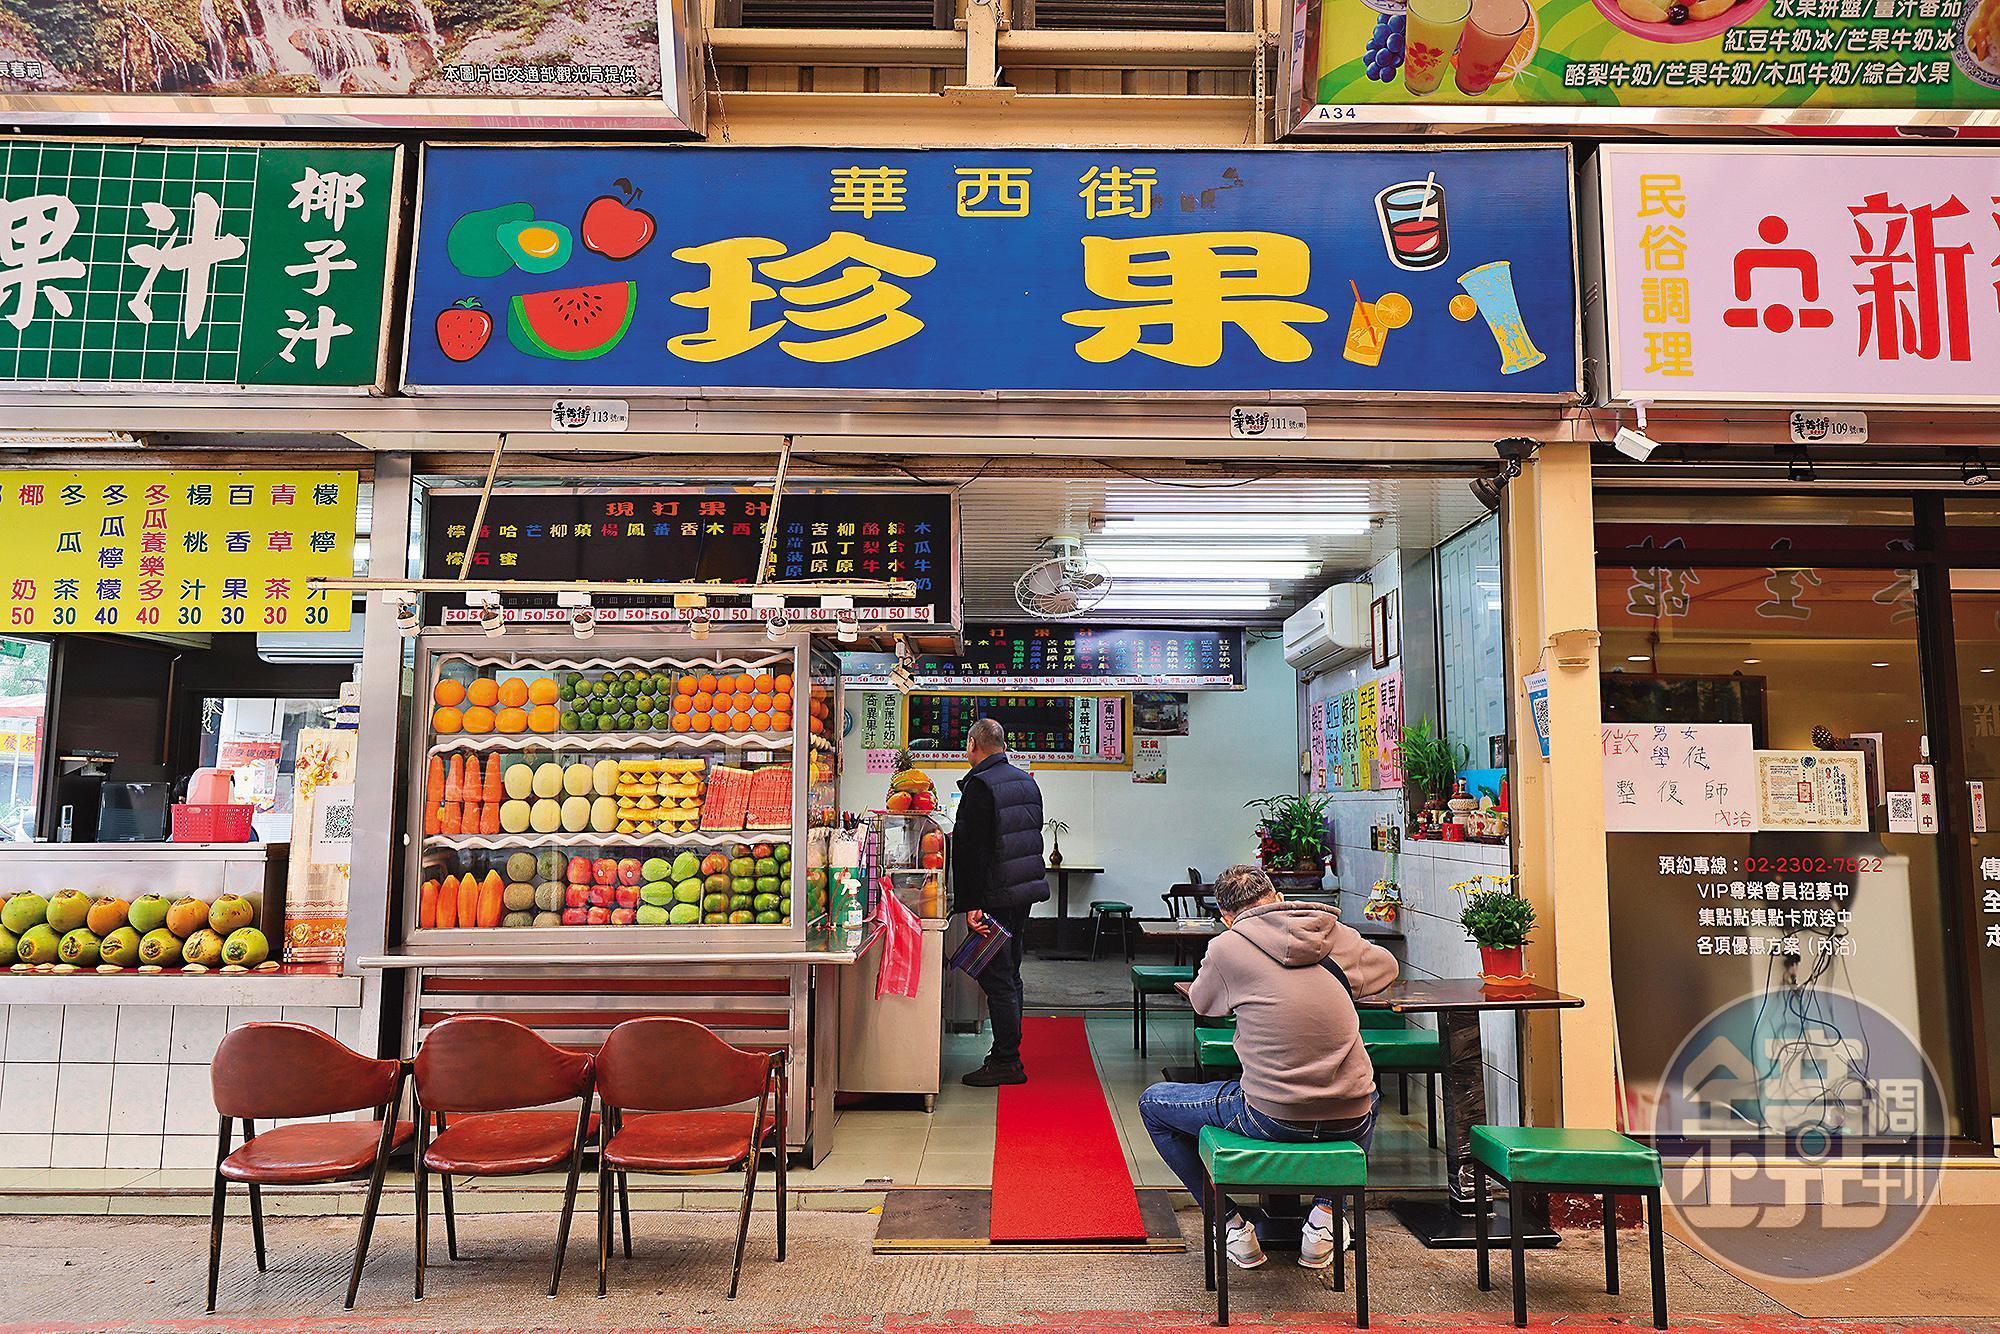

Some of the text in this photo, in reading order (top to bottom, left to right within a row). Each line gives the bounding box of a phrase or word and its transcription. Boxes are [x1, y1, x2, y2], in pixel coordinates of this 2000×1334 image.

[1724, 27, 1956, 52] 紅豆牛奶冰/芒果牛奶冰
[443, 65, 637, 83] 本圖片由交通部觀光局提供
[1564, 61, 1951, 87] 酪梨牛奶/芒果牛奶/木瓜牛奶/綜合水果
[1319, 107, 1357, 120] A34
[829, 165, 1159, 220] 華西街
[0, 192, 246, 341] 果汁
[277, 166, 366, 370] 椰子汁
[1635, 173, 1694, 378] 民俗調理
[1847, 190, 2000, 363] 新
[666, 230, 1330, 368] 珍果
[606, 501, 770, 517] 現打果汁
[53, 484, 87, 601] 冬瓜茶
[96, 484, 129, 601] 冬瓜檸檬
[138, 484, 170, 601] 冬瓜養樂多
[180, 484, 212, 601] 楊桃汁
[222, 484, 255, 600] 百香果
[264, 483, 297, 600] 青草茶
[11, 606, 35, 625] 50
[53, 606, 77, 625] 30
[94, 606, 118, 625] 40
[136, 606, 161, 625] 40
[178, 606, 202, 625] 30
[221, 606, 245, 625] 30
[263, 606, 288, 625] 30
[304, 606, 329, 625] 30
[446, 610, 466, 620] 50
[524, 610, 543, 621] 50
[545, 610, 565, 620] 50
[600, 609, 617, 620] 50
[625, 609, 644, 620] 50
[650, 610, 669, 620] 50
[679, 608, 694, 620] 50
[732, 608, 748, 620] 50
[810, 608, 827, 619] 80
[863, 608, 879, 619] 70
[889, 608, 905, 619] 50
[914, 608, 930, 619] 50
[1652, 725, 1698, 741] 男女
[1650, 745, 1710, 770] 學徒
[1616, 779, 1729, 805] 整復師
[1919, 771, 1933, 828] 營業中
[1696, 881, 1850, 901] VIP尊榮會員招募中
[1698, 907, 1853, 928] 集點點集點卡放送中
